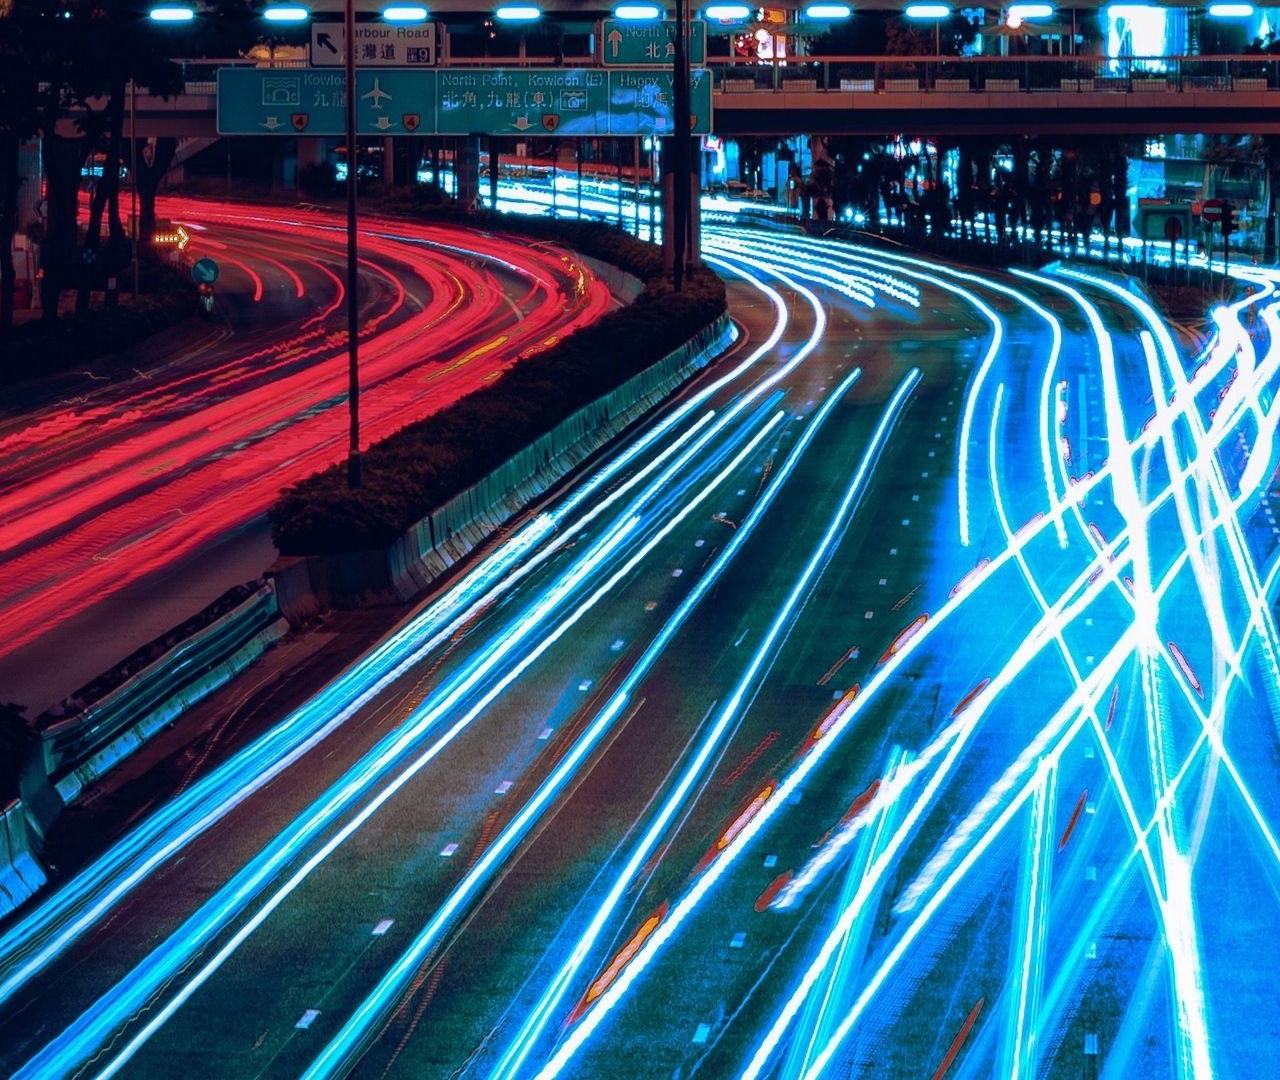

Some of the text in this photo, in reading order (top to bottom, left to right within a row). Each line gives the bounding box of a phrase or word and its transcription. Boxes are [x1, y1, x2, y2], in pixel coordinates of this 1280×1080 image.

[342, 27, 429, 39] arbour Road
[625, 25, 660, 37] North
[304, 74, 356, 86] Kowlo
[442, 74, 476, 86] North
[528, 74, 580, 86] Kowloon
[620, 73, 658, 89] Happy
